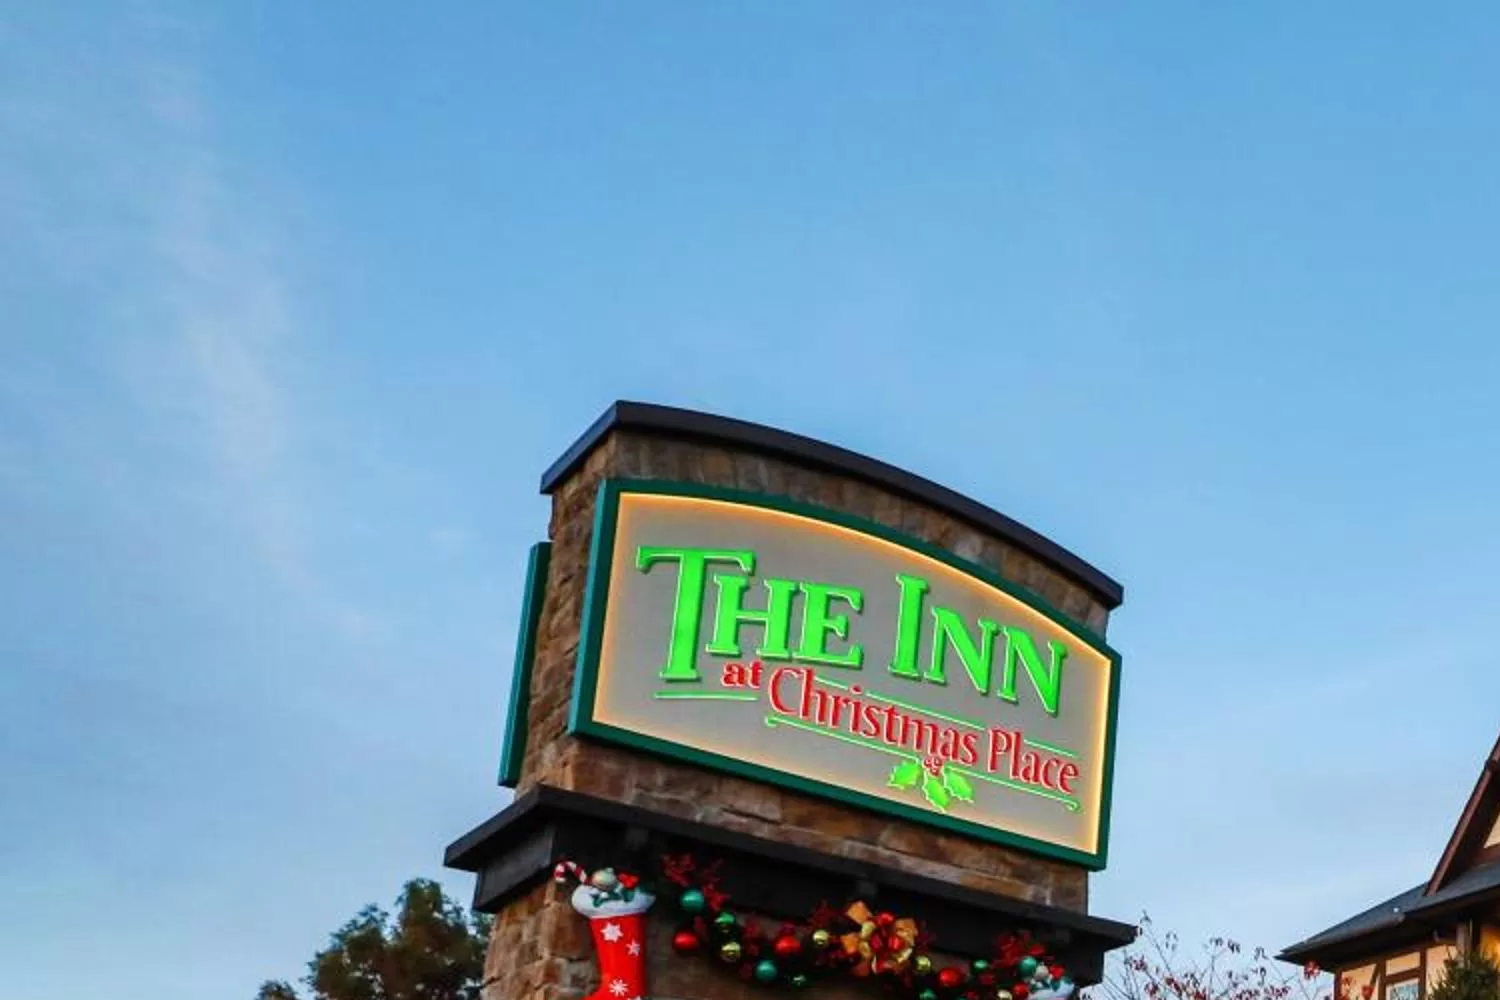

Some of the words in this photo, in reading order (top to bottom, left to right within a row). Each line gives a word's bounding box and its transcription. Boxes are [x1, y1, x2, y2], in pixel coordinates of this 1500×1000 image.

[637, 546, 864, 680] THE
[888, 574, 1067, 716] INN
[720, 659, 763, 690] at
[768, 667, 979, 766] Christmas
[987, 727, 1080, 793] Place
